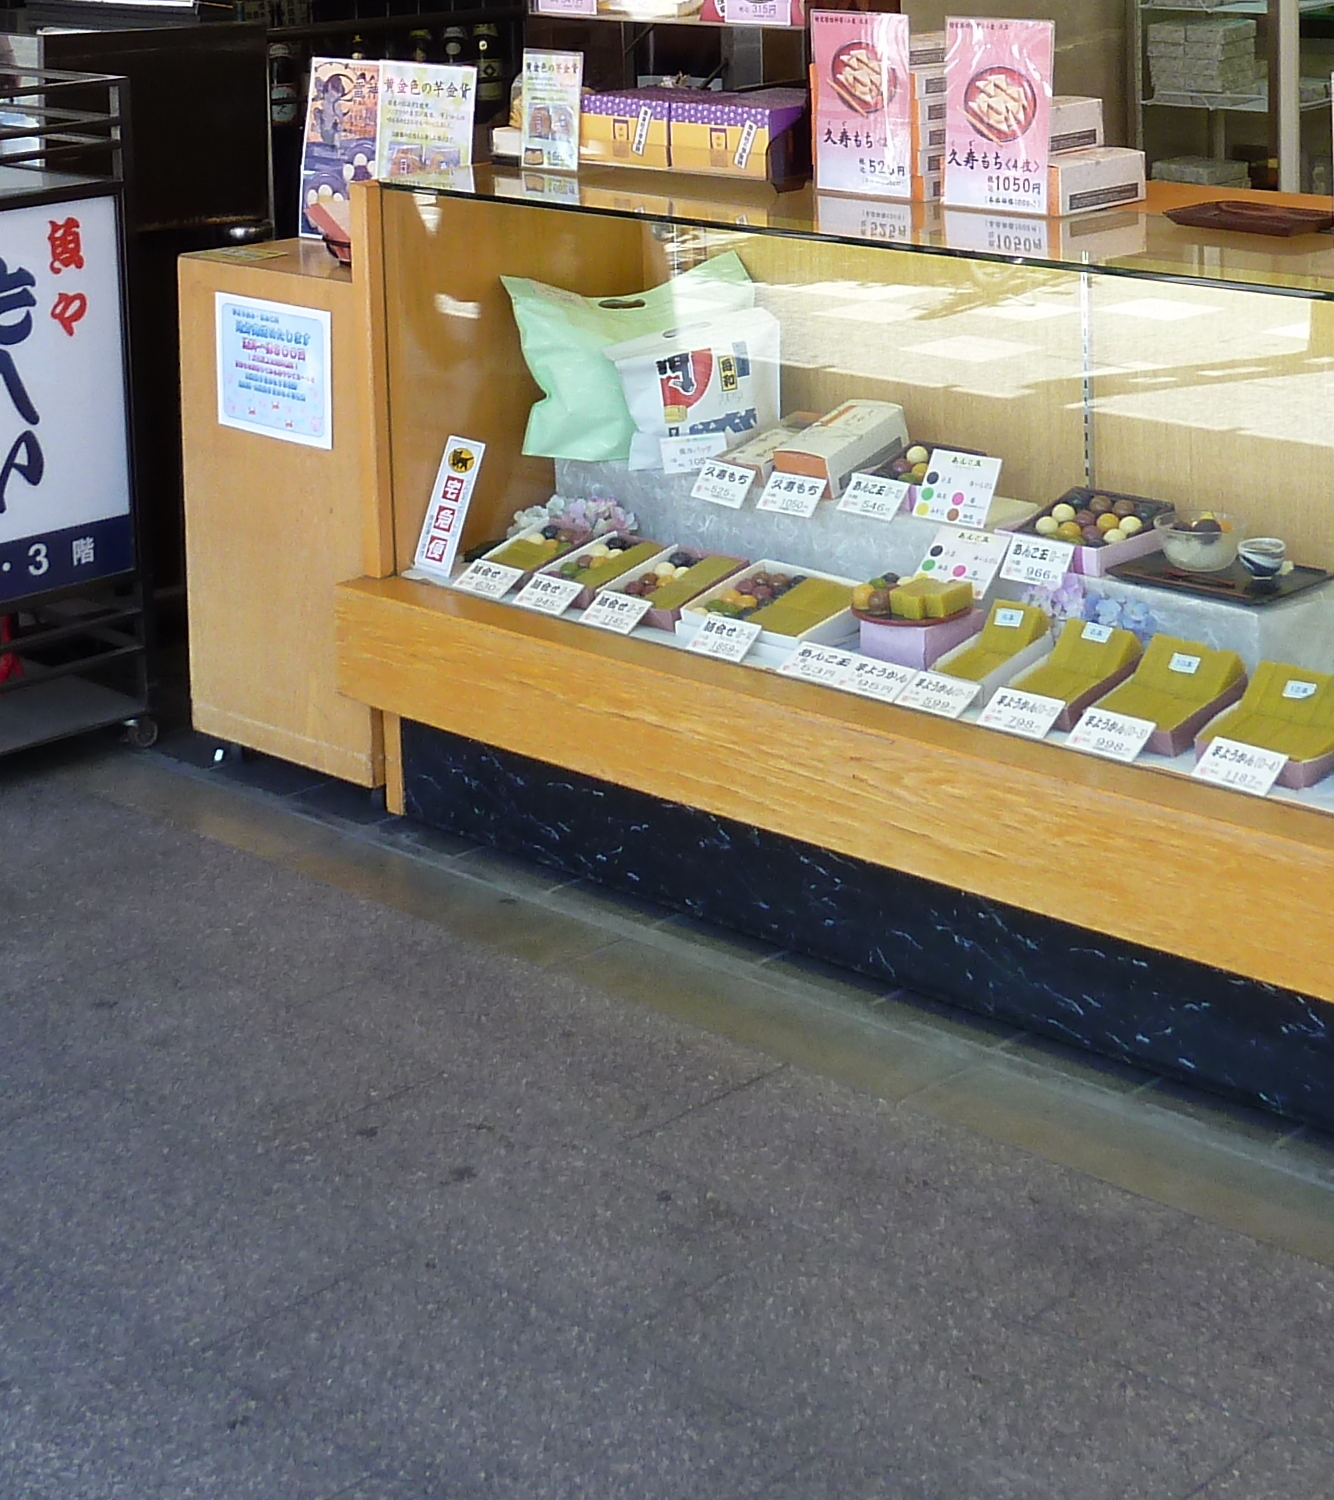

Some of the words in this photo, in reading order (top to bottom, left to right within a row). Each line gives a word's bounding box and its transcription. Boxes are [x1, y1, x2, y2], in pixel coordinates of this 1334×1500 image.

[994, 175, 1042, 196] 1050円
[704, 465, 750, 485] 久寿もち
[770, 478, 820, 496] 久寿もち
